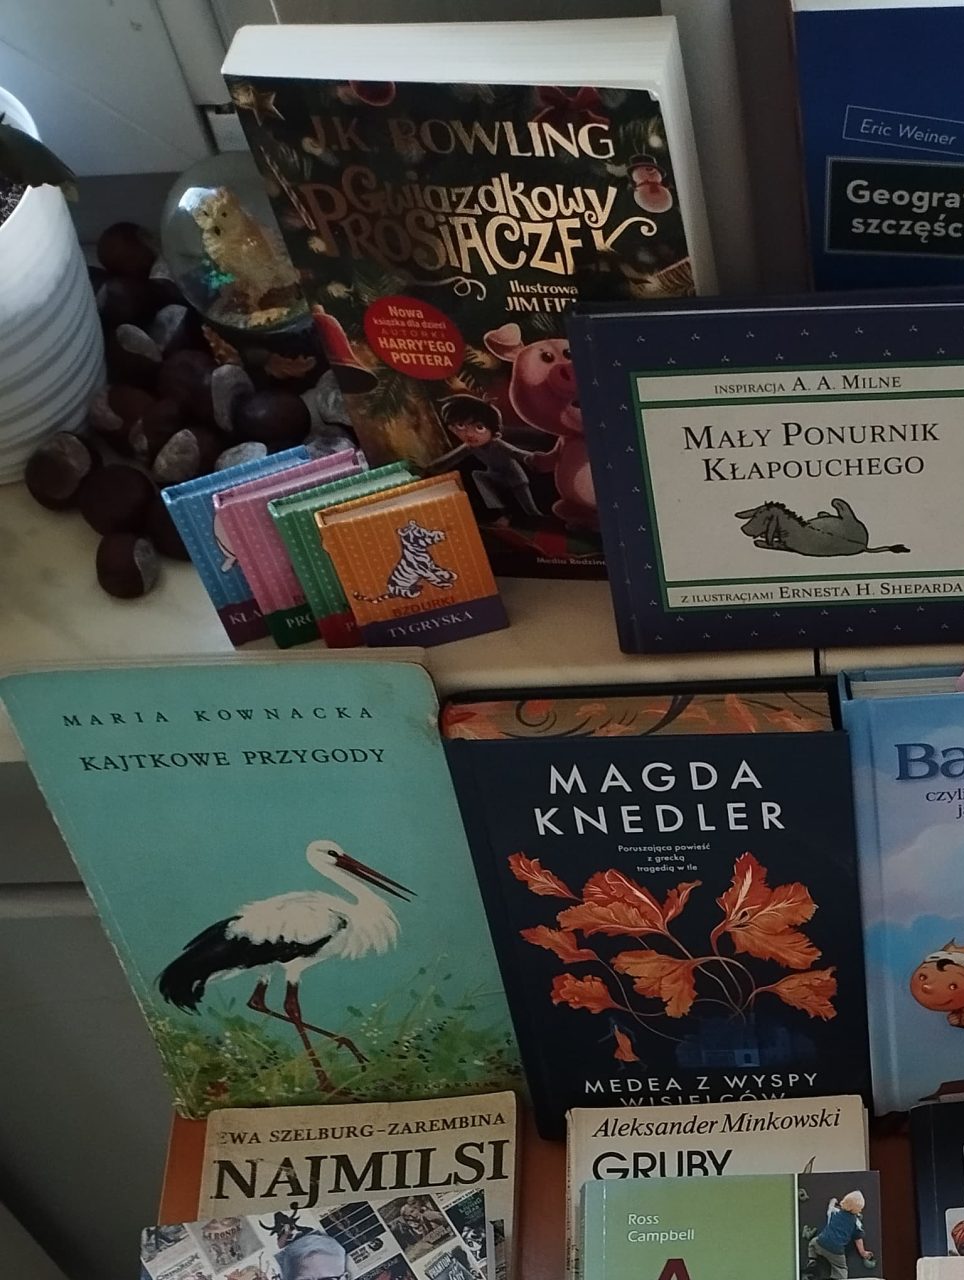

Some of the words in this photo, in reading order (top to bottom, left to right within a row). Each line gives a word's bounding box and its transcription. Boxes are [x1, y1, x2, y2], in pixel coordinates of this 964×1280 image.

[860, 119, 891, 136] Eric
[899, 123, 956, 147] Weiner
[388, 306, 423, 319] Nowa
[378, 337, 455, 353] HARRY'EGO
[392, 352, 453, 367] POTTERA
[792, 377, 811, 392] A.
[817, 376, 836, 391] A.
[388, 610, 473, 639] TYGRYSKA
[63, 711, 169, 727] MARIA
[195, 706, 372, 722] KOWNACKA
[80, 750, 229, 772] KAJTKOWE
[243, 747, 385, 766] PRZYGODY
[549, 760, 762, 795] MAGDA
[534, 802, 785, 835] KNEDLER
[675, 842, 711, 853] powieść
[655, 854, 684, 864] grecką
[637, 865, 674, 874] tragedią
[585, 1077, 680, 1094] MEDEA
[697, 1076, 711, 1089] Z
[725, 1073, 817, 1089] WYSPY
[592, 1117, 718, 1137] Aleksander
[720, 1108, 840, 1133] Minkowski
[210, 1139, 510, 1209] NAJMILSI
[628, 1214, 659, 1225] Ross
[628, 1229, 694, 1243] Campbell
